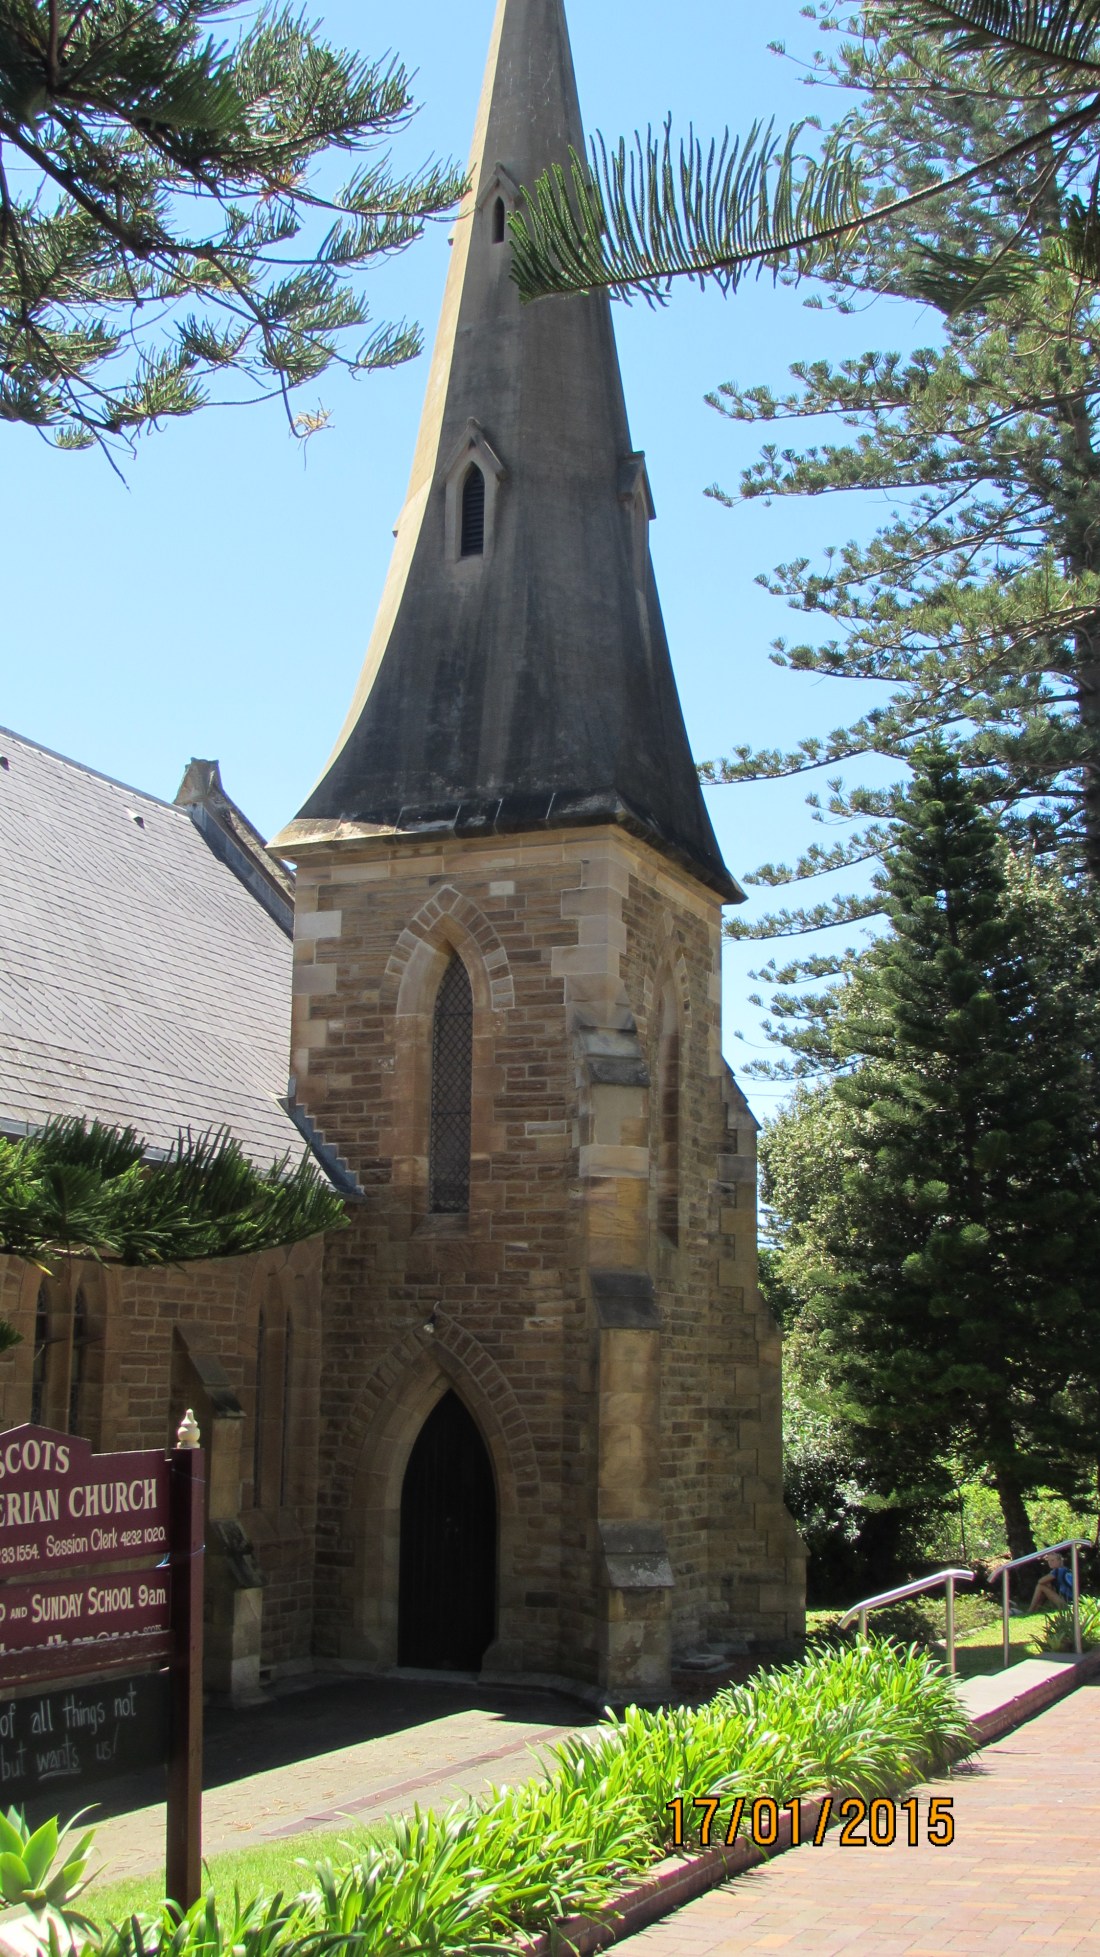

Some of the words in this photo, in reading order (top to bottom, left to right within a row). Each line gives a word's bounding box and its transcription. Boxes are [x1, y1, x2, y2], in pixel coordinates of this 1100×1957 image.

[69, 1479, 158, 1518] CHURCH
[46, 1534, 88, 1558] Session
[91, 1527, 118, 1550] Clerk
[10, 1606, 28, 1620] AND
[32, 1593, 83, 1623] SUNDAY
[88, 1586, 134, 1615] SCHOOL
[0, 1703, 16, 1739] of
[30, 1699, 53, 1735] all
[62, 1693, 105, 1735] things
[114, 1681, 137, 1718] not
[0, 1740, 27, 1782] but
[36, 1732, 80, 1773] wants
